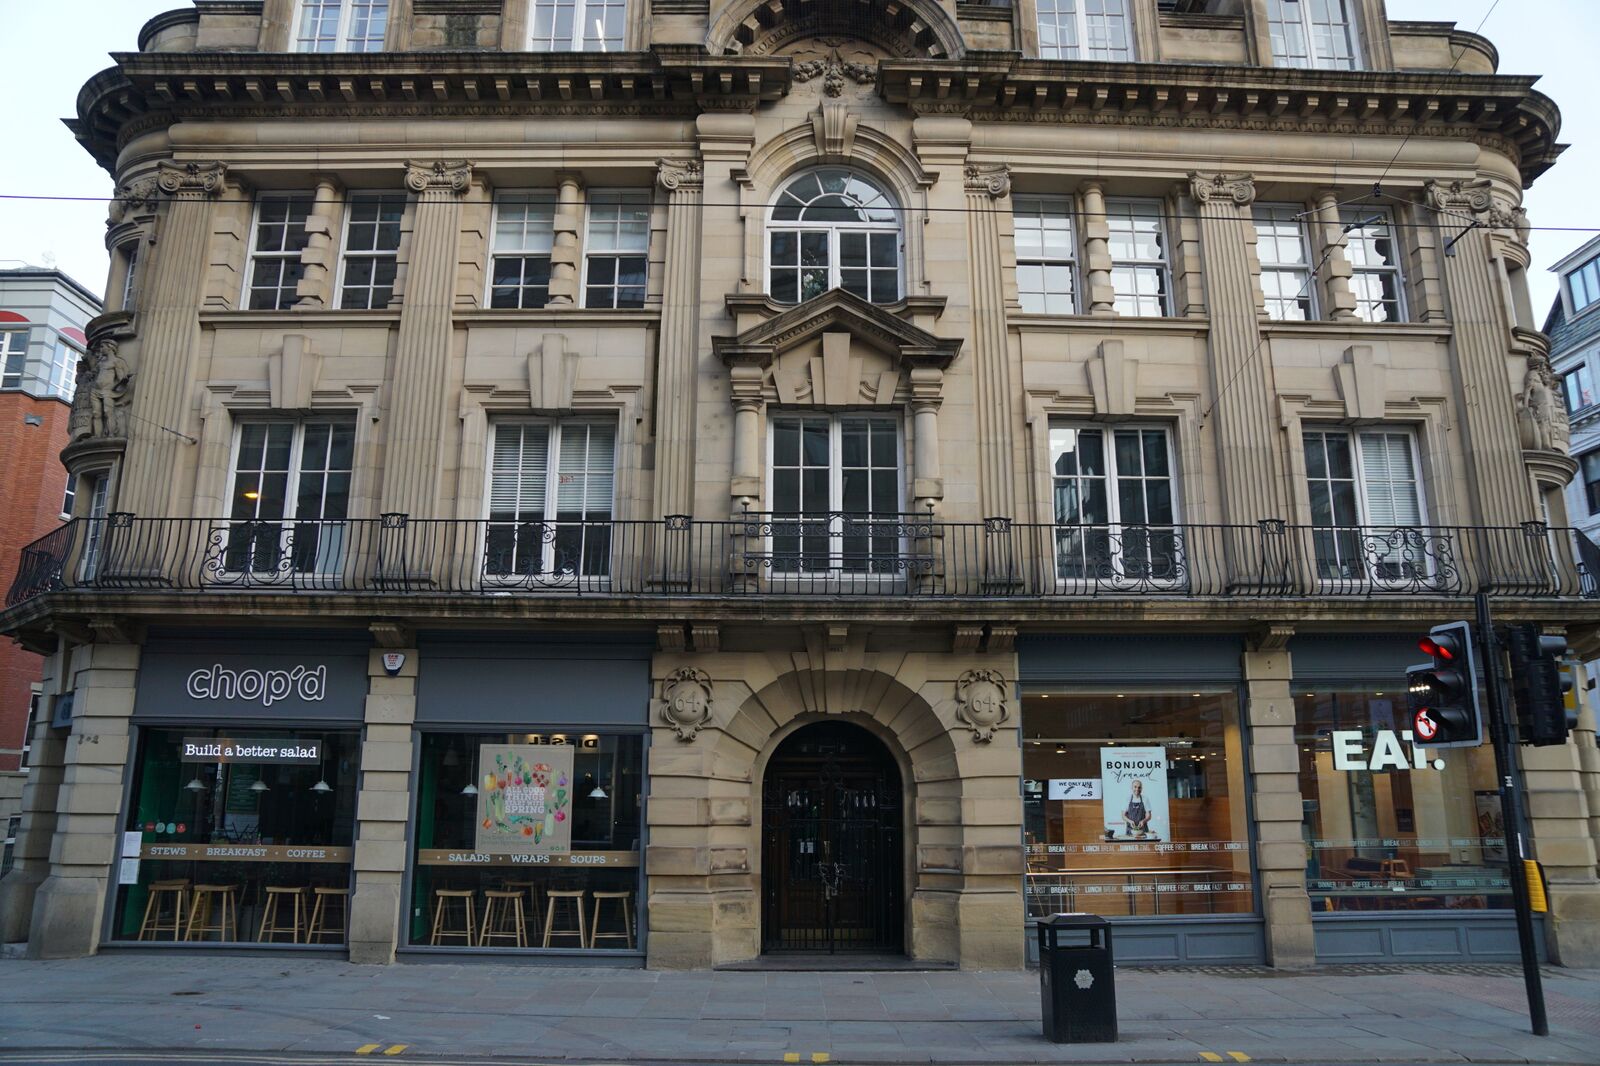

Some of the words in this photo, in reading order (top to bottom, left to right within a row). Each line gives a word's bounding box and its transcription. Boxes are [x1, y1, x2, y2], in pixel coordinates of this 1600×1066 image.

[186, 663, 327, 707] chop'd
[184, 743, 222, 757] Build
[224, 748, 234, 757] a
[235, 744, 278, 757] better
[279, 746, 318, 759] salad
[1106, 760, 1162, 770] BONJOUR
[505, 805, 545, 814] SPRING
[150, 846, 187, 856] STEWS
[206, 848, 268, 858] BREAKFAST
[286, 849, 326, 859] COFFEE
[1048, 845, 1066, 853] BREAK
[1083, 844, 1100, 852] LUNCH
[1154, 843, 1174, 851] COFFEE
[1190, 843, 1208, 851] BREAK
[448, 853, 491, 863] SALADS
[510, 854, 550, 864] WRAPS
[570, 855, 606, 864] SOUPS
[1050, 886, 1067, 894] BREAK
[1085, 885, 1102, 893] LUNCH
[1157, 884, 1177, 892] COFFEE
[1193, 883, 1211, 891] BREAK
[1227, 883, 1245, 891] LUNCH
